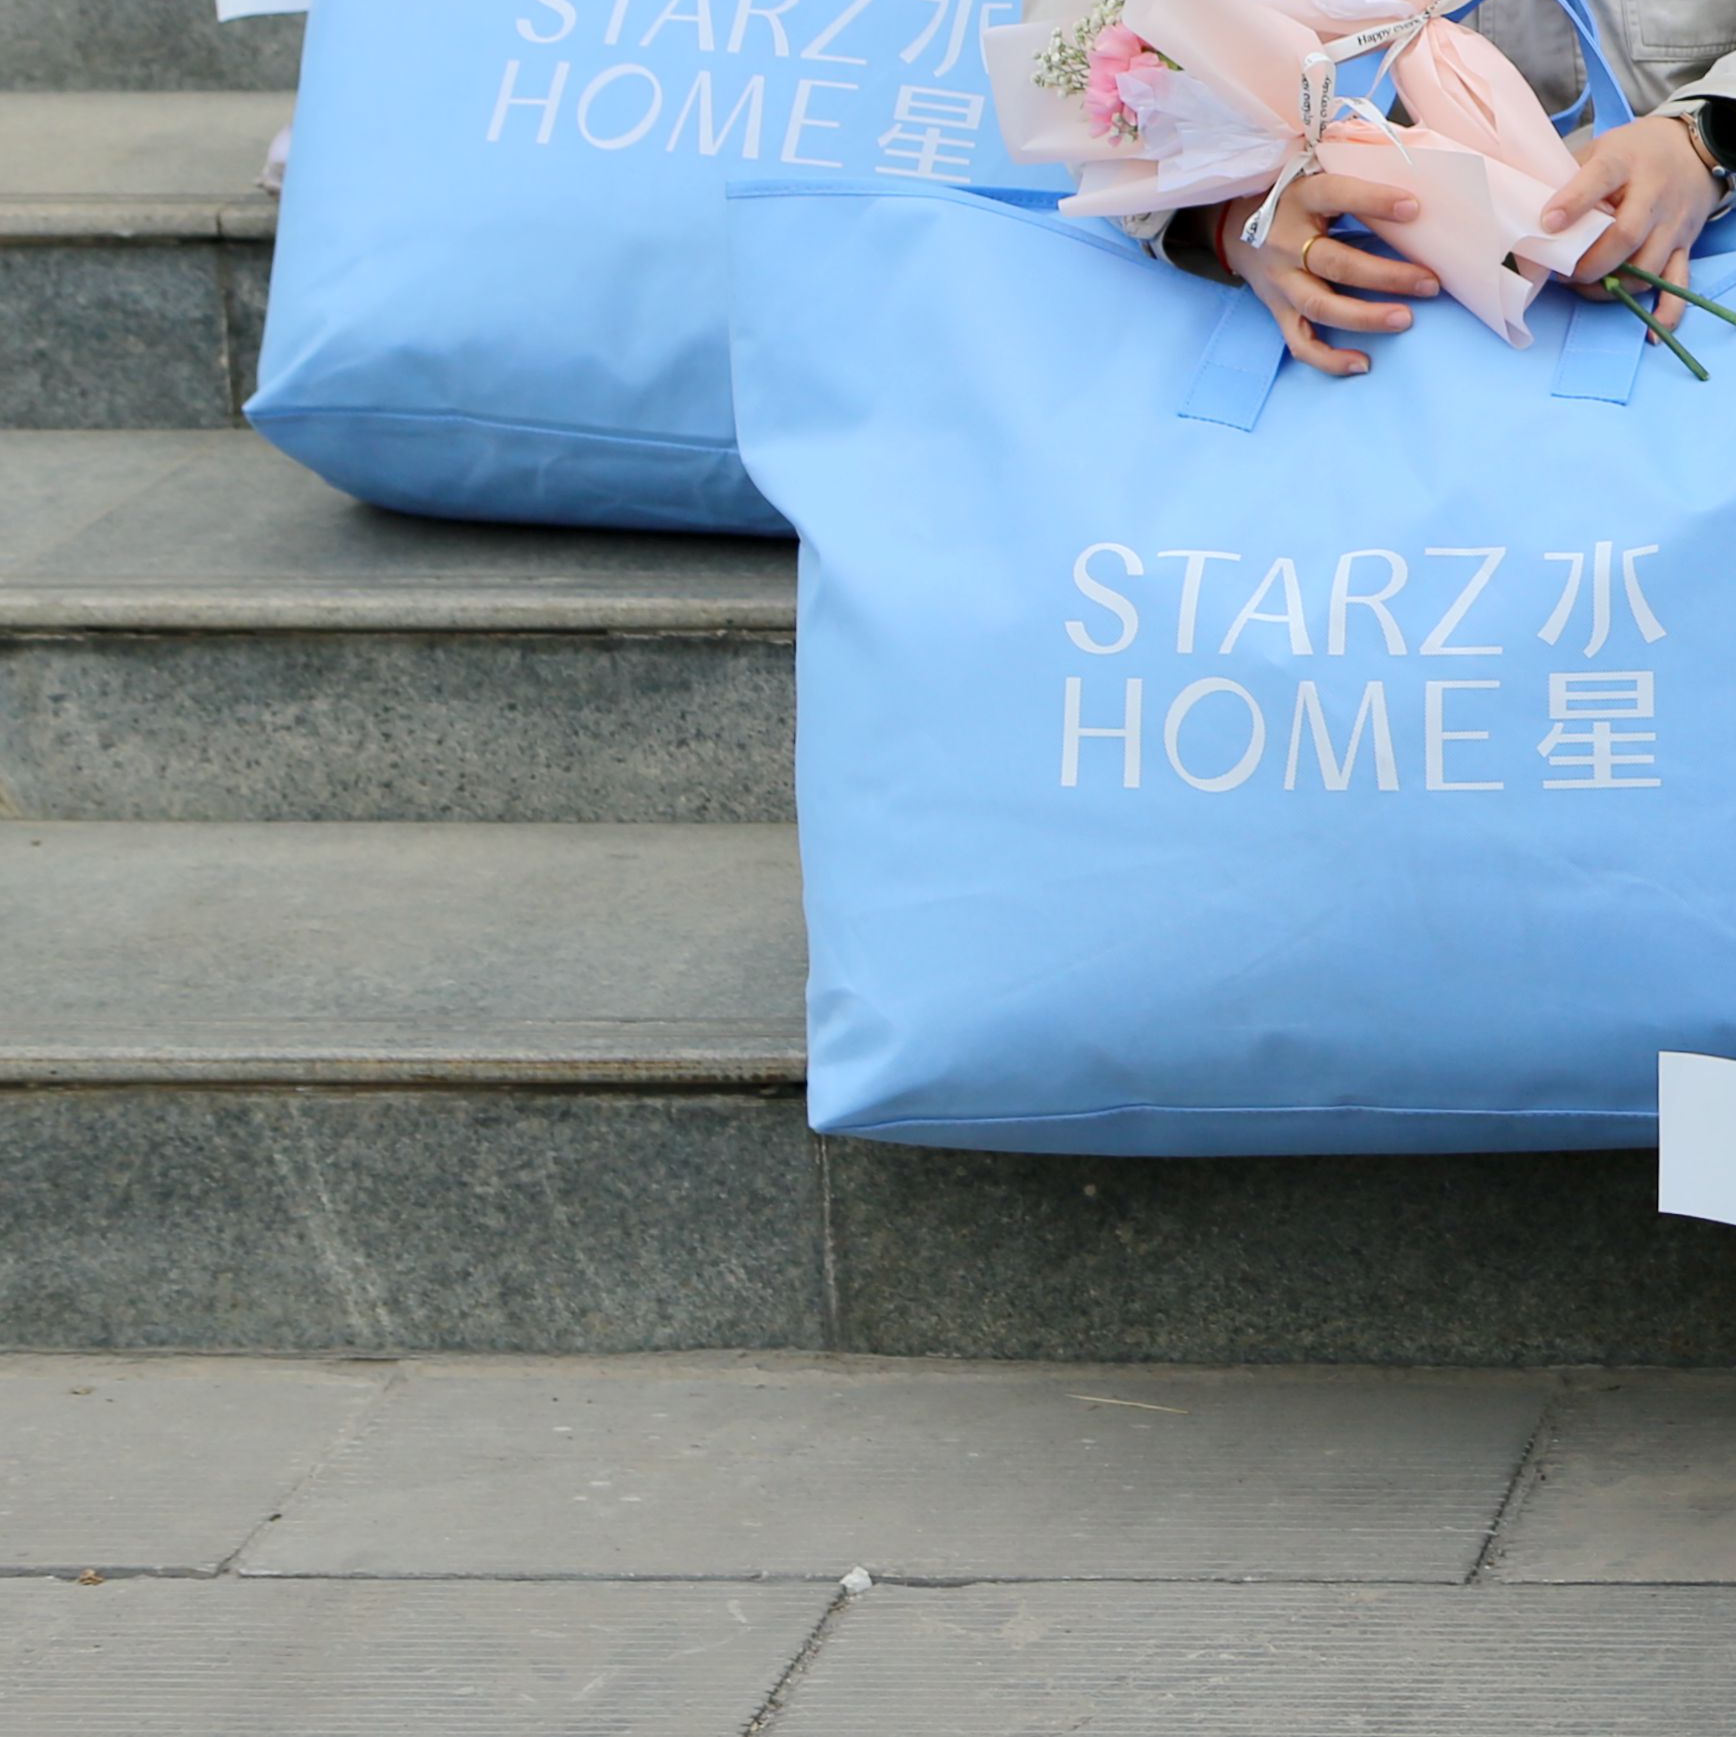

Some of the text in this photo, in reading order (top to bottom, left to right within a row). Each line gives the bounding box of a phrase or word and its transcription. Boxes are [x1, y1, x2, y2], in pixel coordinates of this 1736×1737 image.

[1357, 27, 1392, 46] Happy
[486, 59, 985, 184] HOME 星
[1064, 540, 1667, 659] STARZ 水
[1060, 671, 1661, 793] HOME 星
